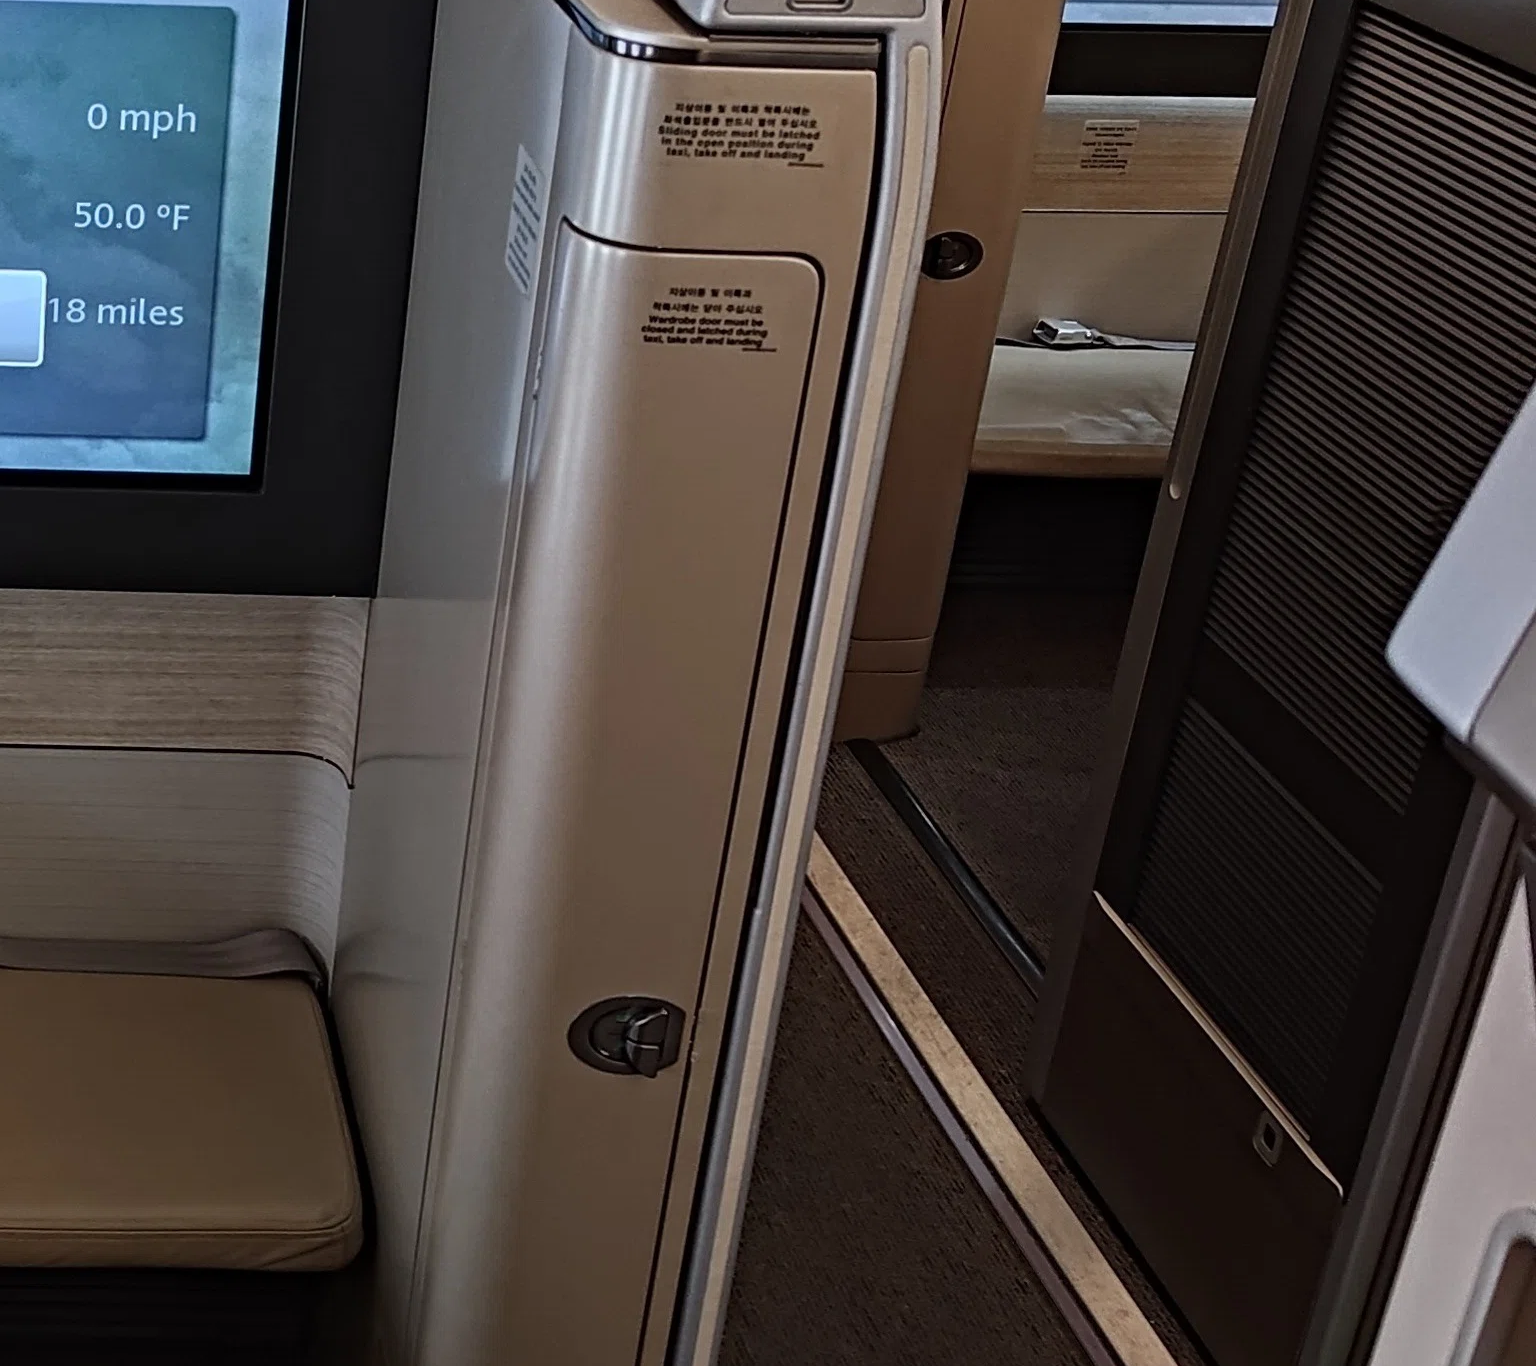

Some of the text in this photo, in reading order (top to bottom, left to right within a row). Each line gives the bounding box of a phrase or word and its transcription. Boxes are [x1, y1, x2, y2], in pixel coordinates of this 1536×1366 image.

[87, 103, 197, 139] 0 mph
[701, 129, 727, 137] door
[731, 130, 758, 138] must
[762, 130, 775, 138] be
[74, 202, 146, 230] 50.0
[97, 297, 184, 326] miles
